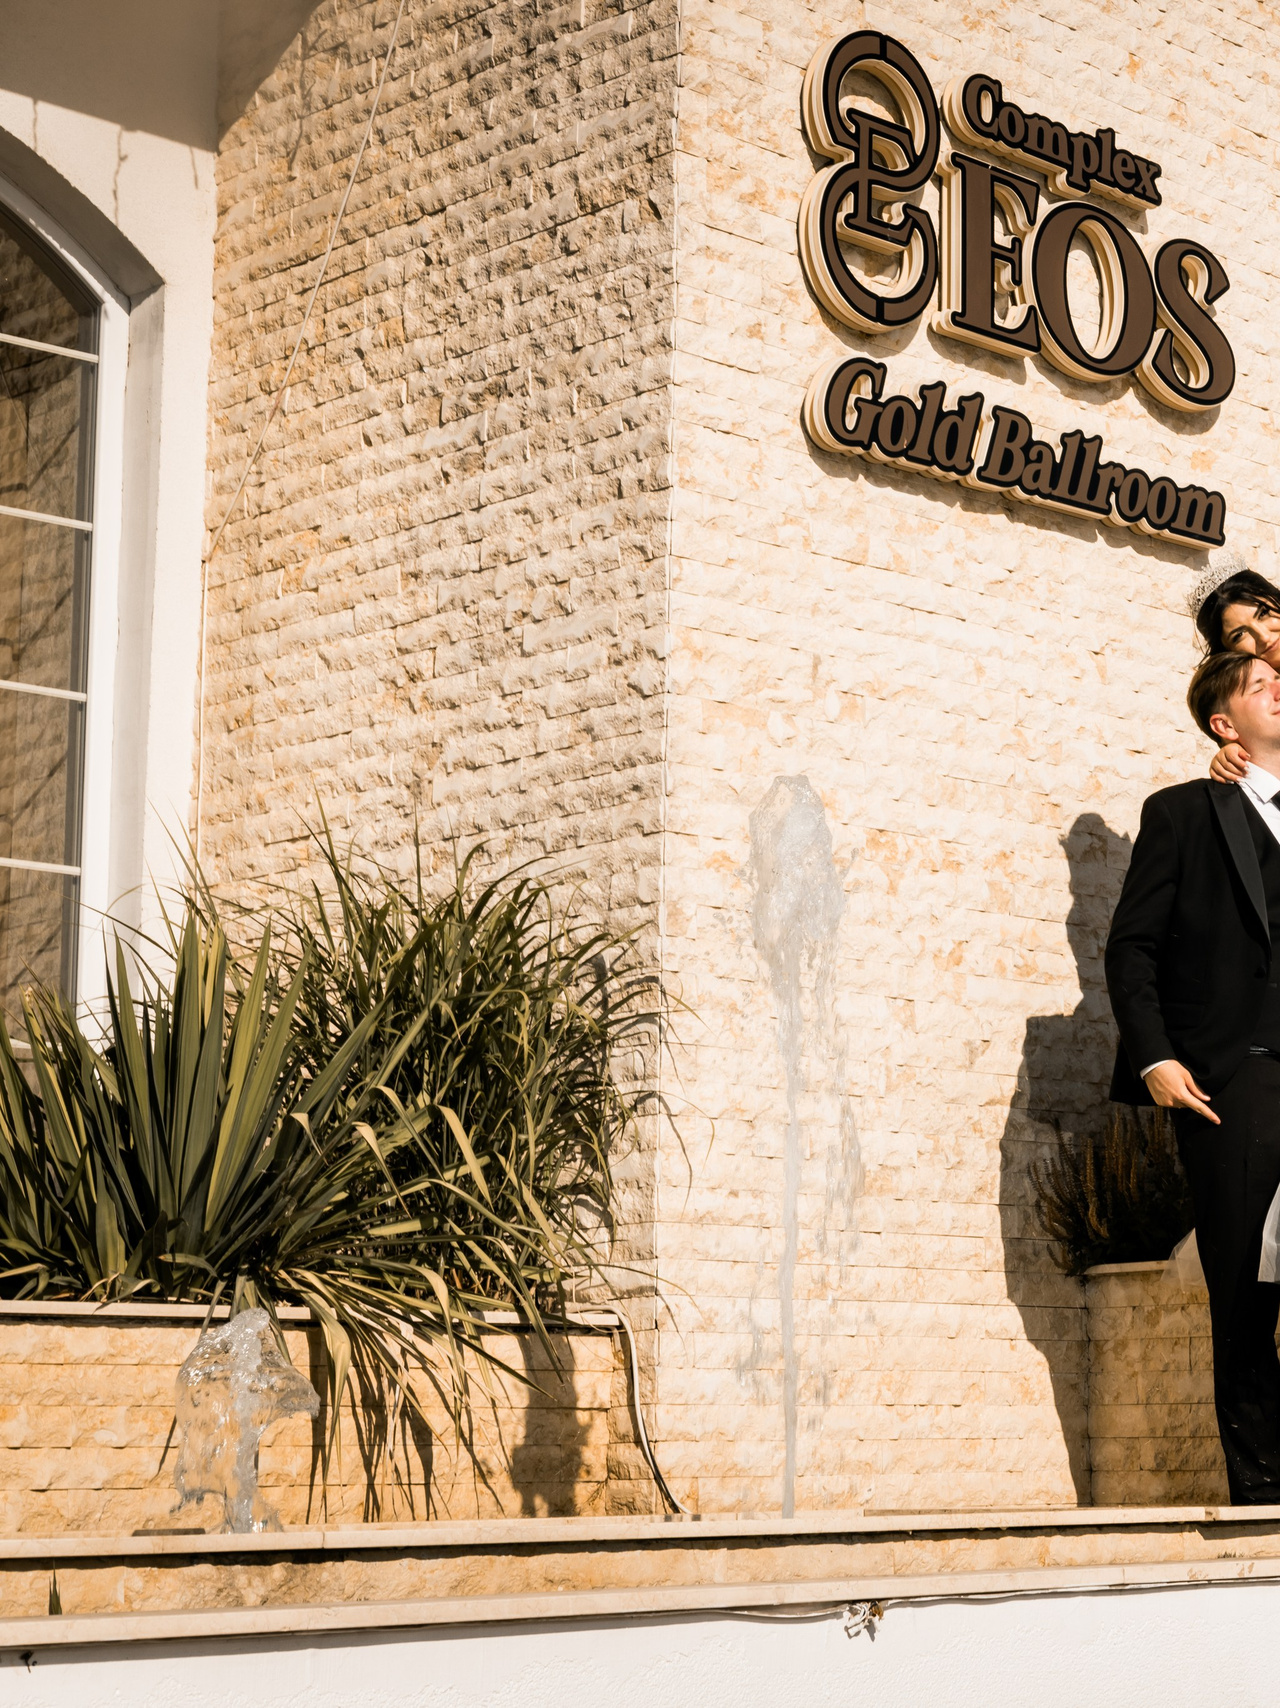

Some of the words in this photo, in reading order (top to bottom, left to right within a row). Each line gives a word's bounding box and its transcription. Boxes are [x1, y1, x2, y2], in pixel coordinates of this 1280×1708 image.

[961, 73, 1163, 207] Complex
[950, 152, 1236, 401] EOS
[824, 357, 985, 476] Gold
[977, 405, 1227, 547] Ballroom
